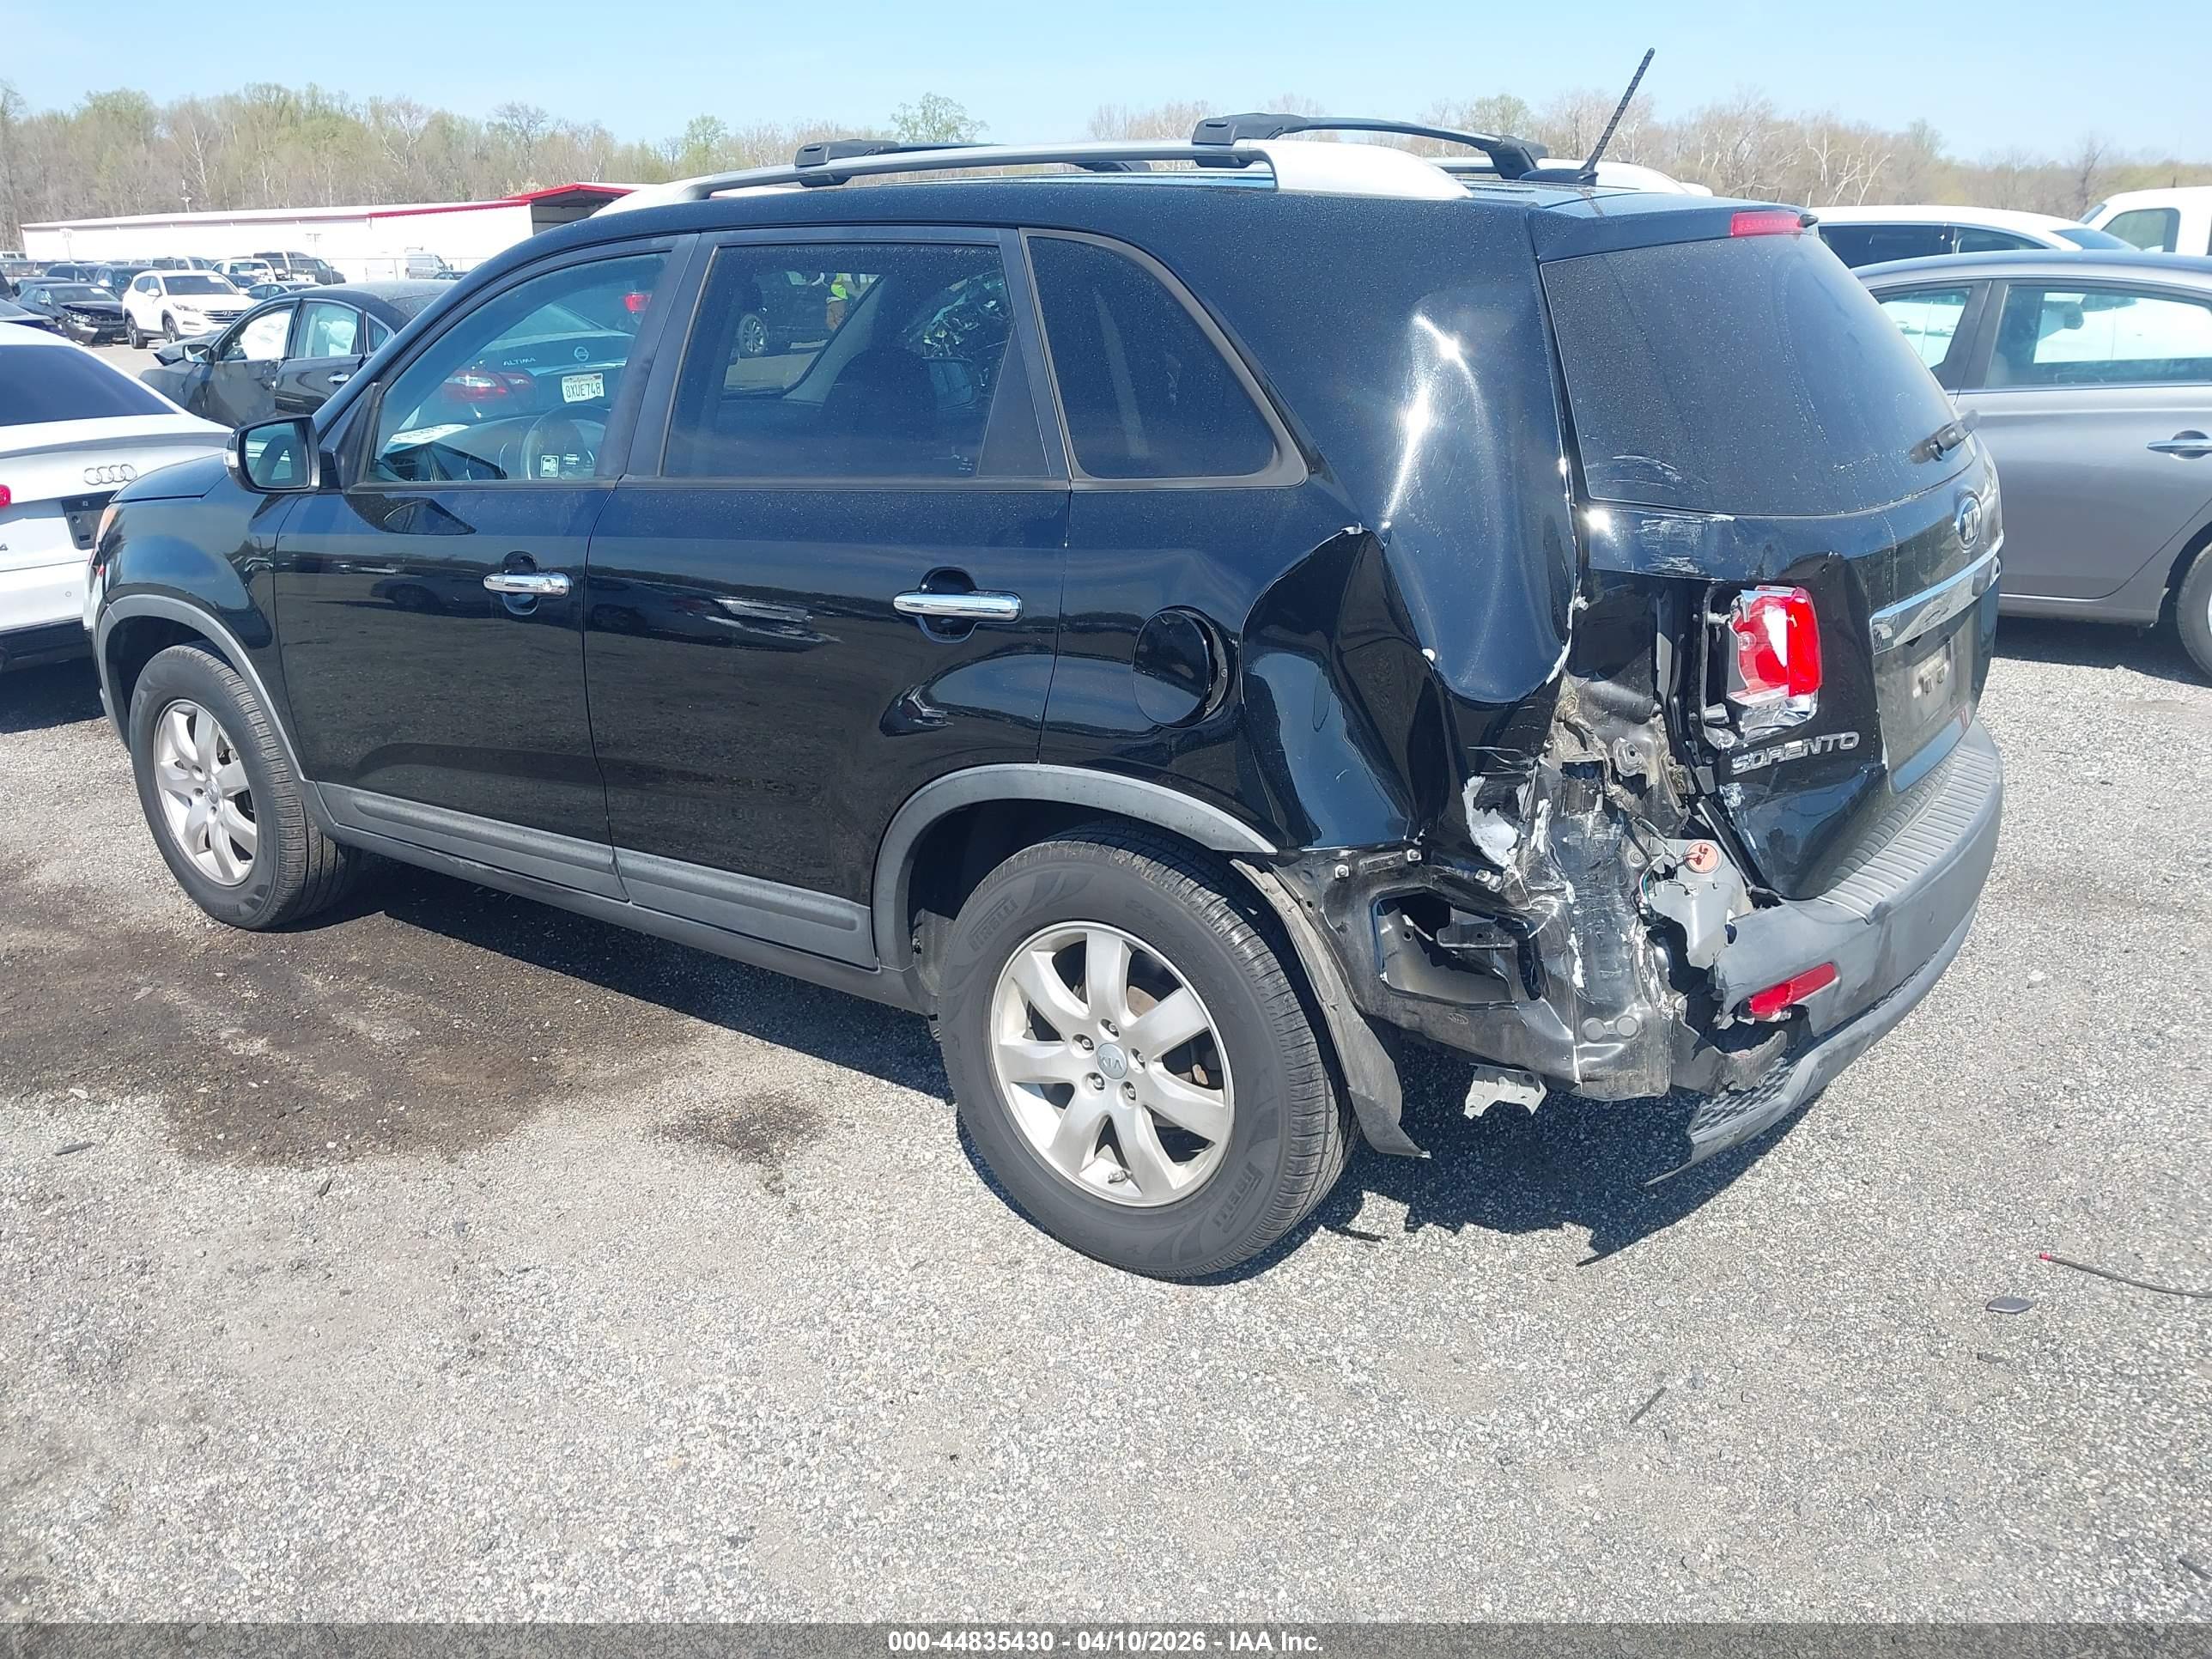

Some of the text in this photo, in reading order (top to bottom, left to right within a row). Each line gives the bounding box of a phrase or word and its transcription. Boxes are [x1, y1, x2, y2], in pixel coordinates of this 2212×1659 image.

[503, 357, 537, 367] ALTIMA
[565, 382, 601, 398] 8XUE748
[1730, 731, 1861, 776] SORENTO
[1099, 1055, 1123, 1071] KIA
